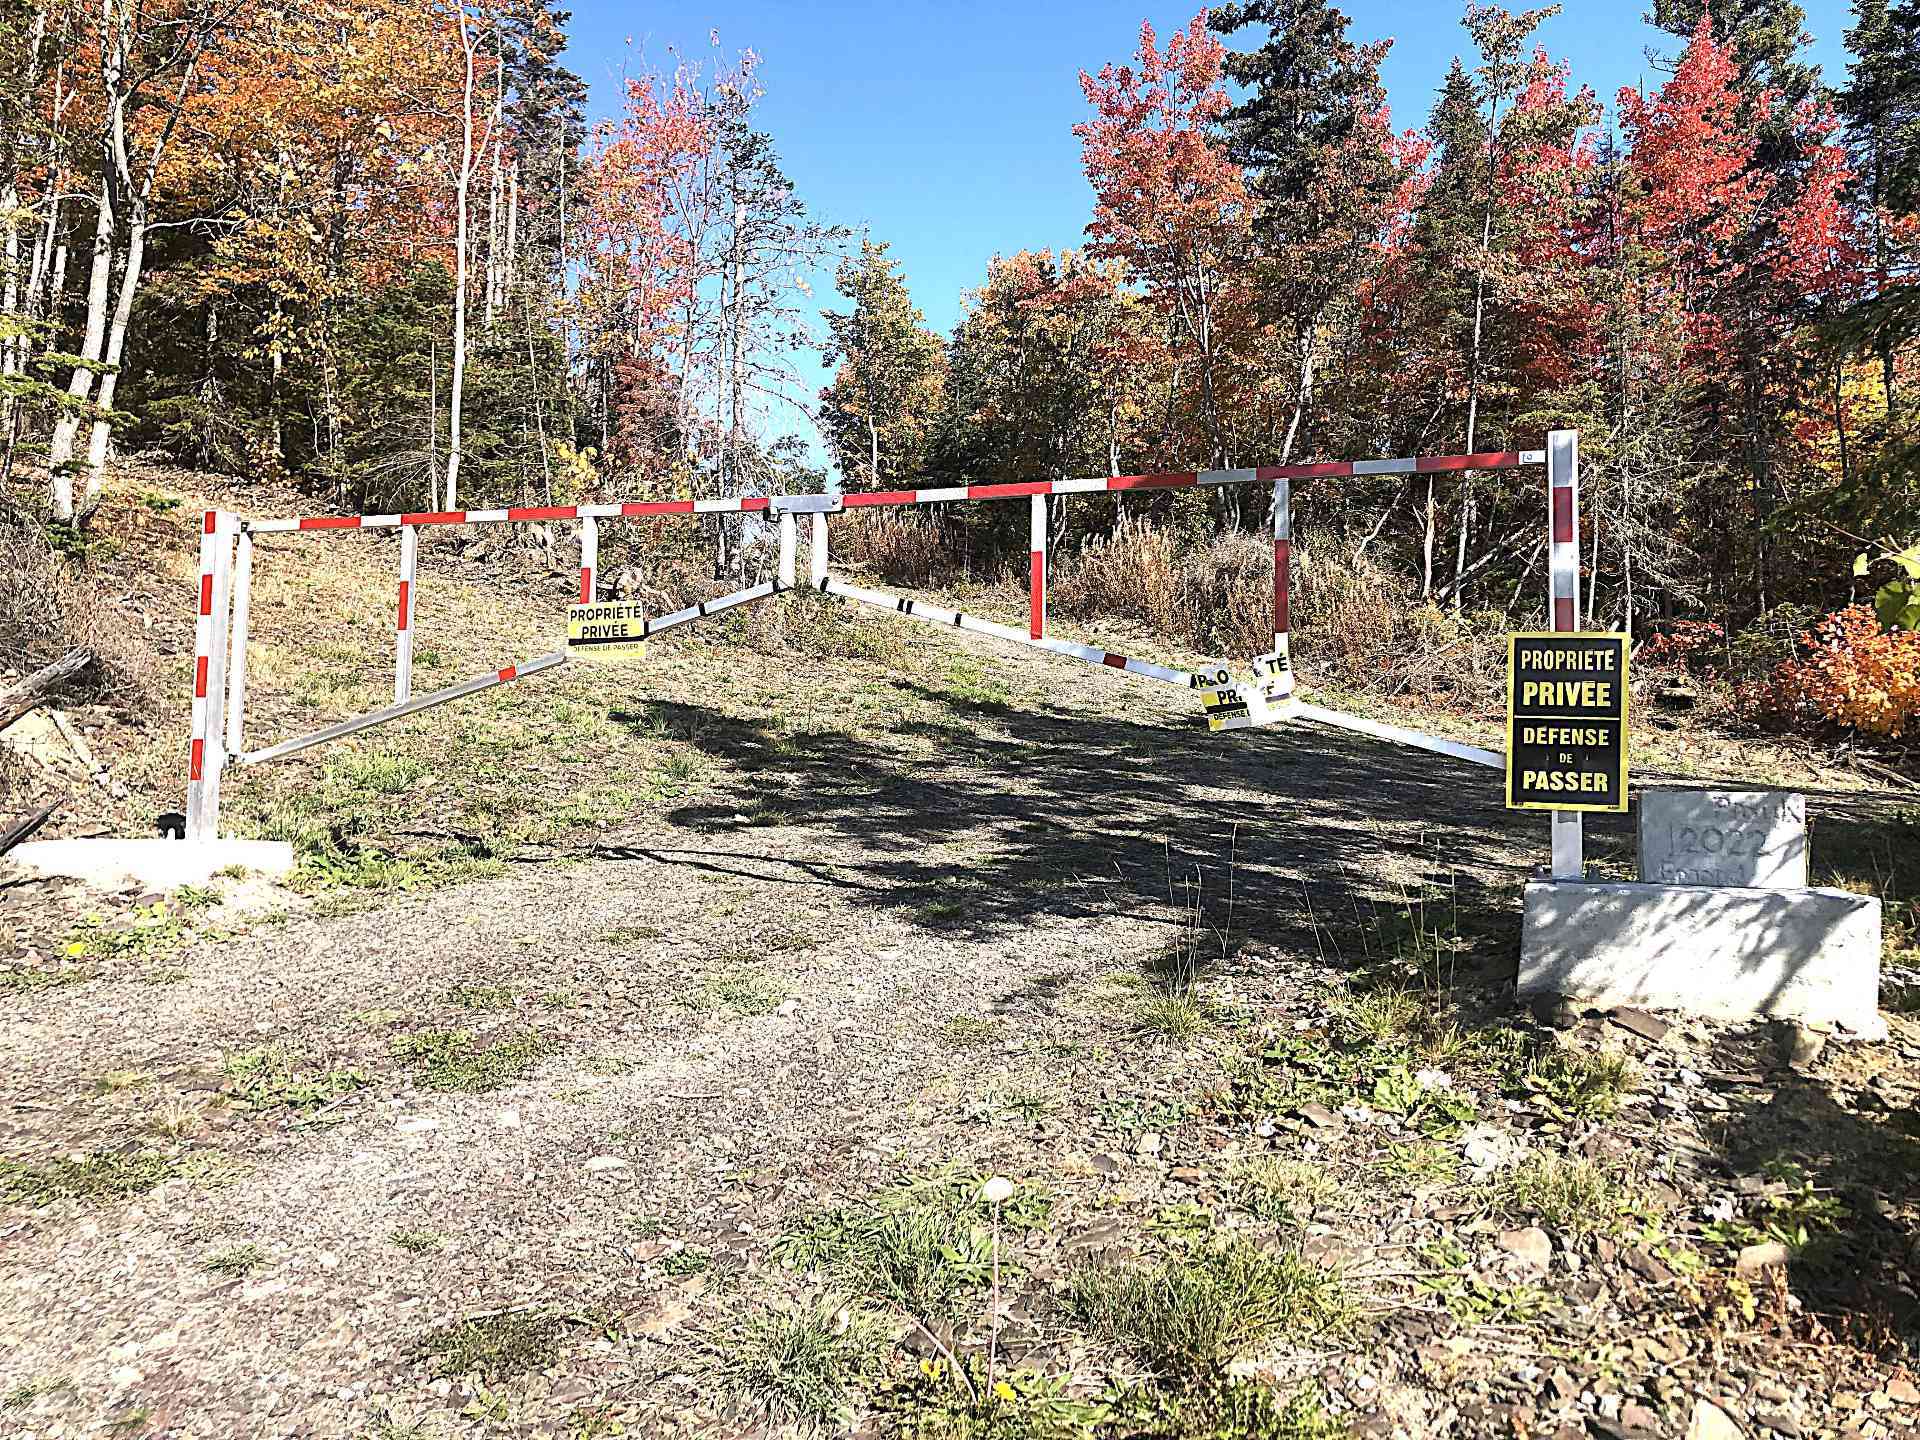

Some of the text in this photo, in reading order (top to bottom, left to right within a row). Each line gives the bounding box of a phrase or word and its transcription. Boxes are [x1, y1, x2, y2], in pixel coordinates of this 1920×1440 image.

[570, 601, 641, 622] PROPRIÉTÉ
[582, 621, 629, 638] PRIVÉE
[1559, 753, 1573, 764] DE
[1522, 770, 1609, 792] PASSER
